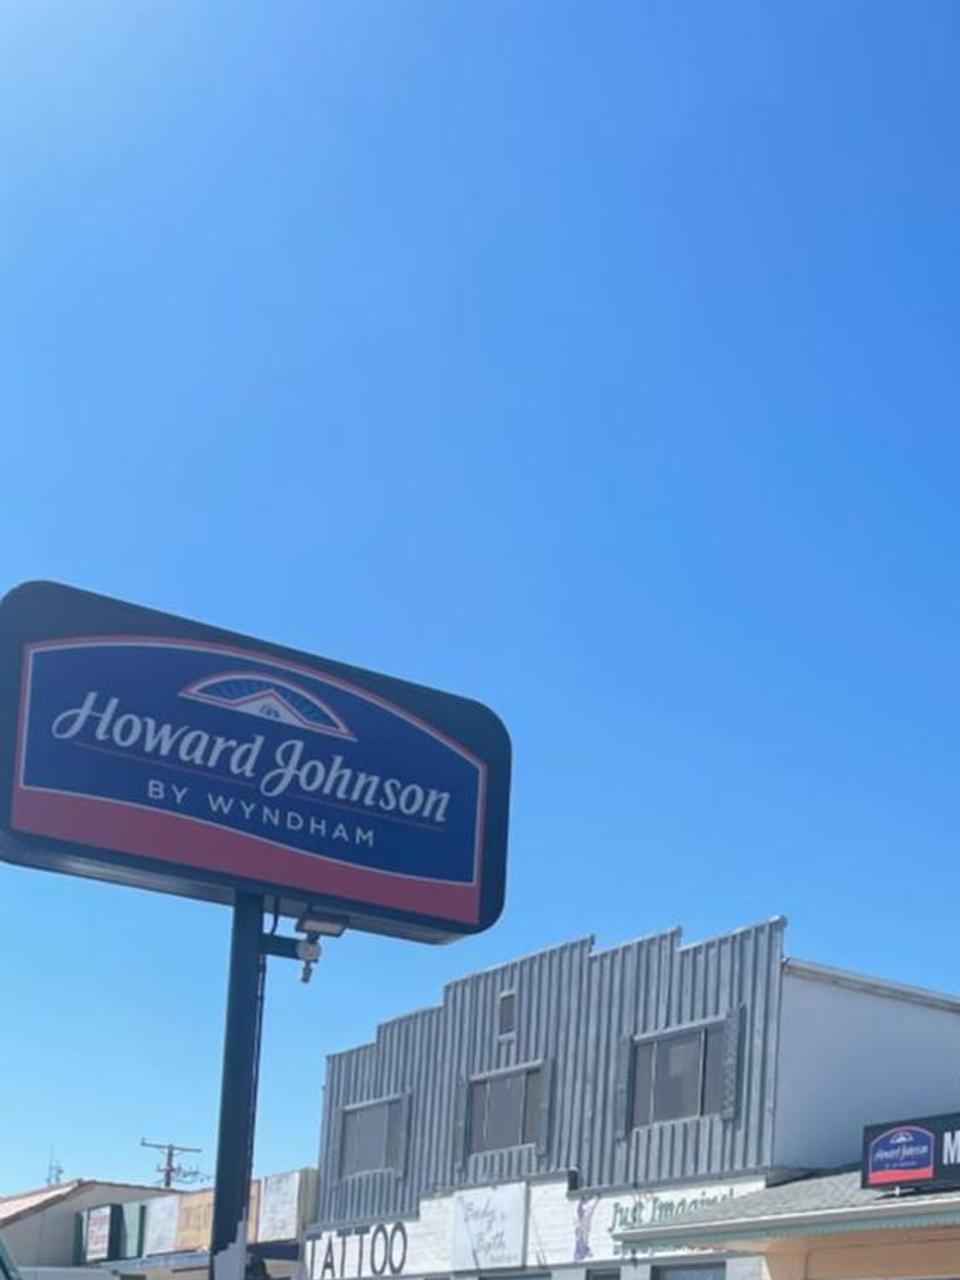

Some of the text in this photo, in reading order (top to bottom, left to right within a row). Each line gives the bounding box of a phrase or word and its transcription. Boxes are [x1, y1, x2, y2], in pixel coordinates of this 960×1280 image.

[52, 692, 450, 822] Howard Johnson
[147, 779, 374, 847] BY WYNDHAM
[306, 1221, 408, 1280] TATTOO
